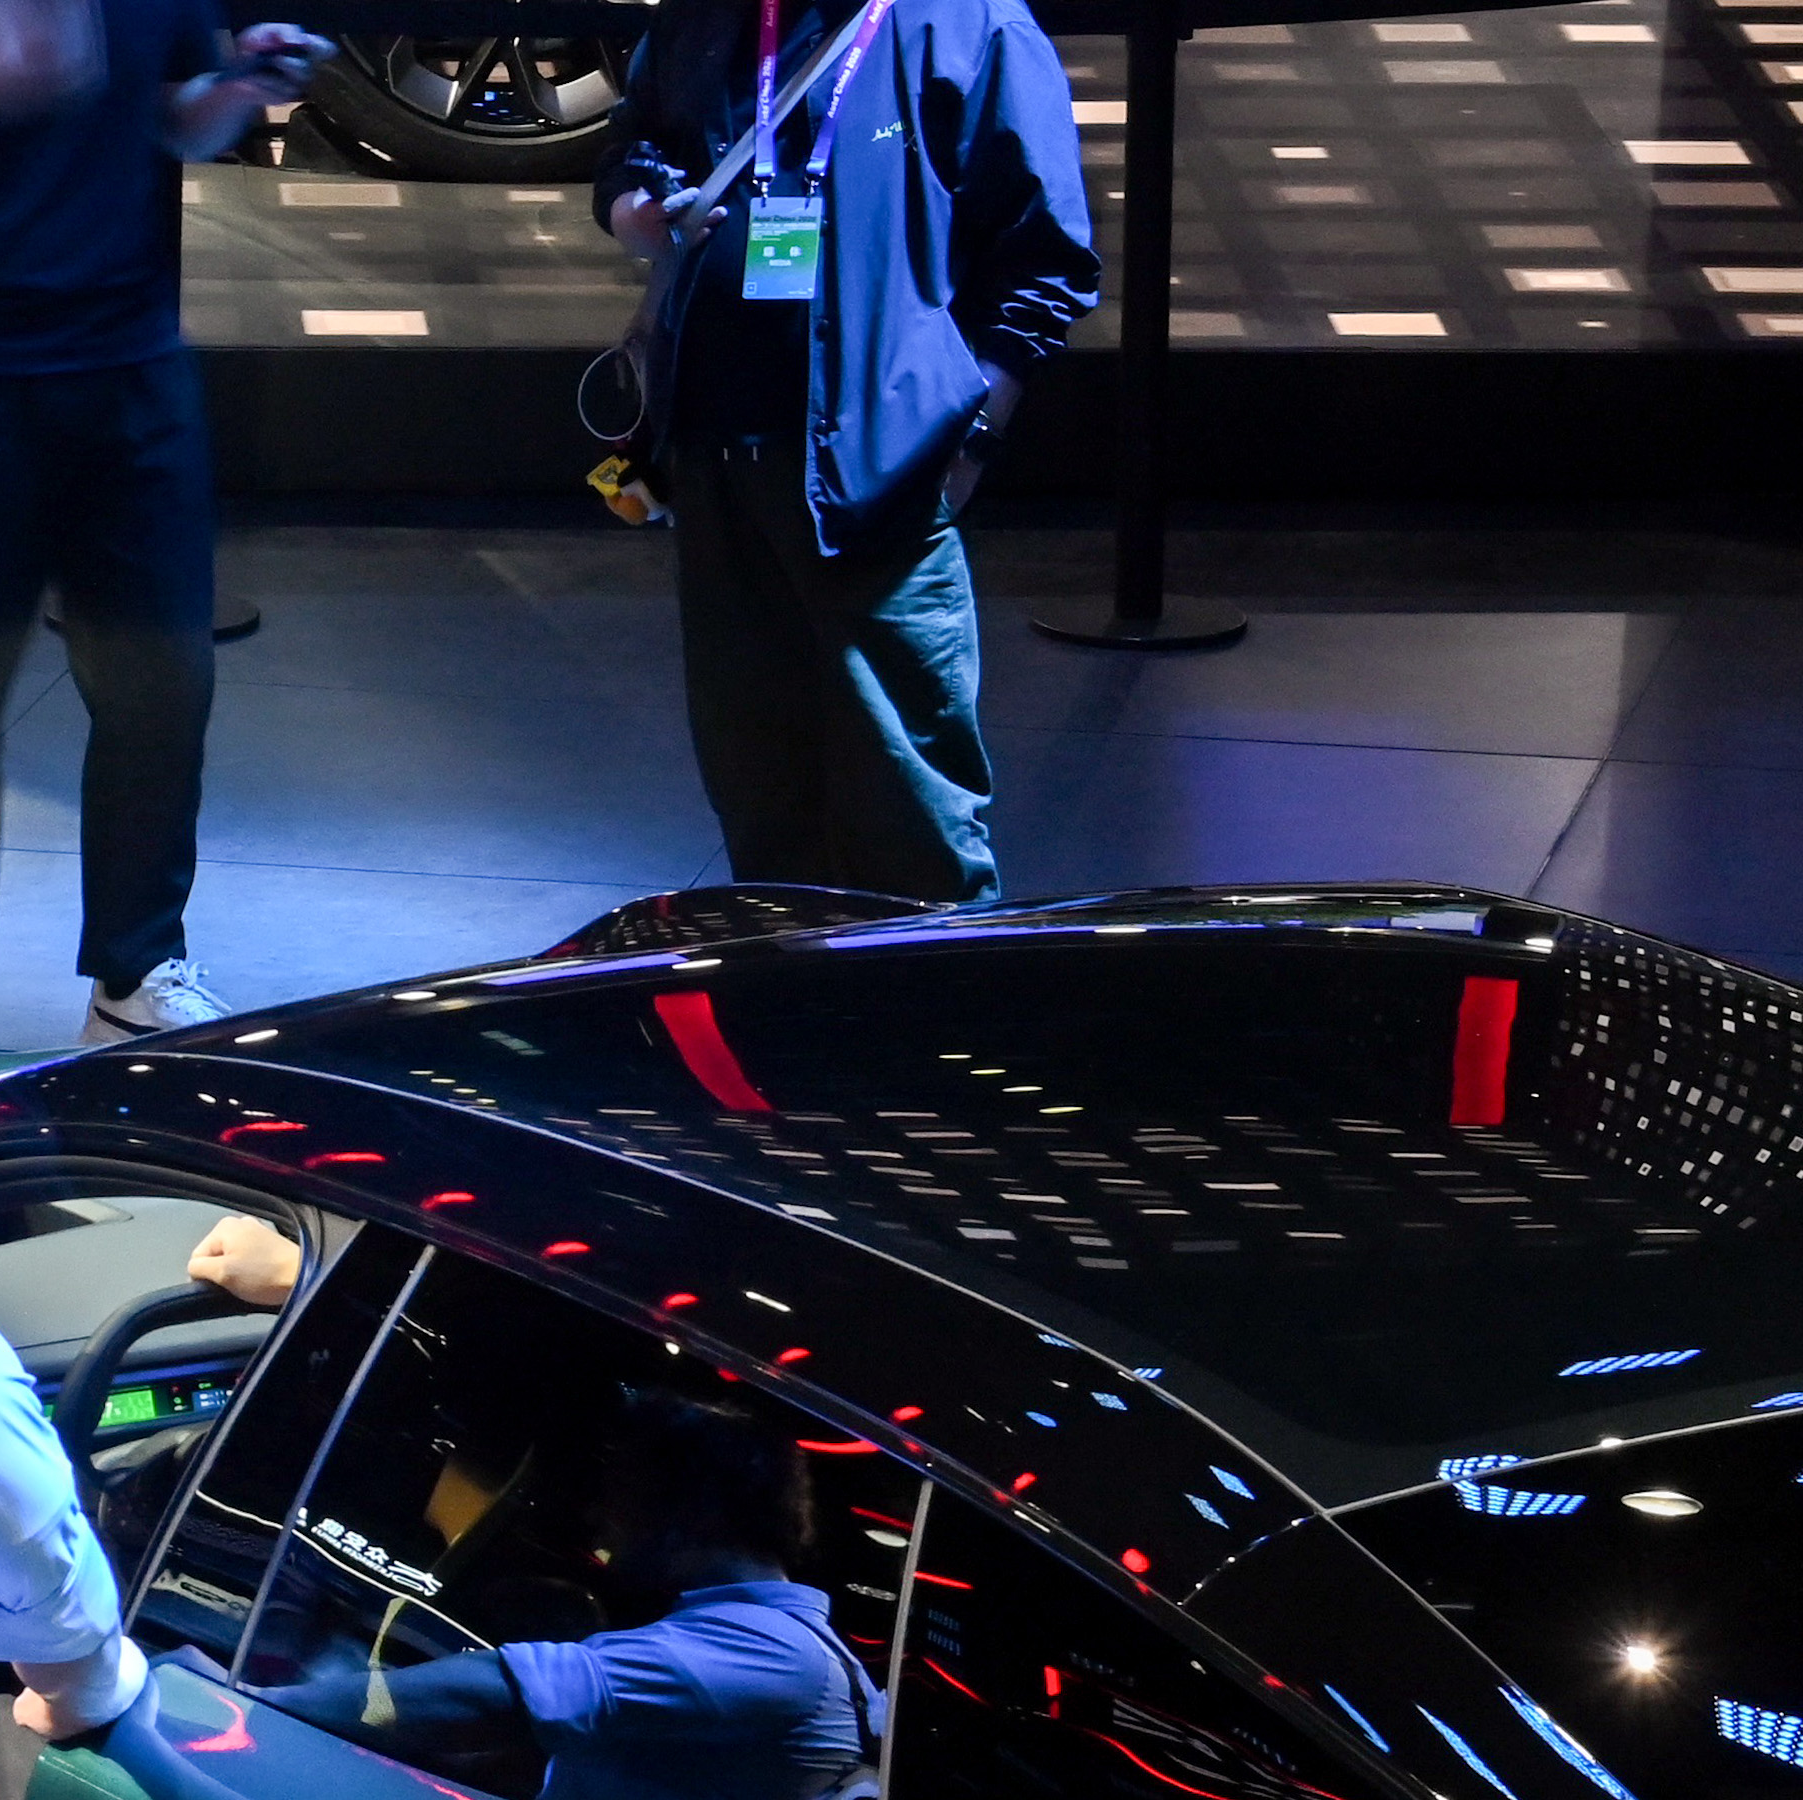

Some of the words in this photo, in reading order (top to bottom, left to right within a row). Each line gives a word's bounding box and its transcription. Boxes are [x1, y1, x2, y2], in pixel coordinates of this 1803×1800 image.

[868, 3, 883, 24] Auto
[760, 79, 771, 104] China
[826, 96, 839, 118] Auto
[833, 69, 851, 95] China
[761, 105, 770, 126] Auto
